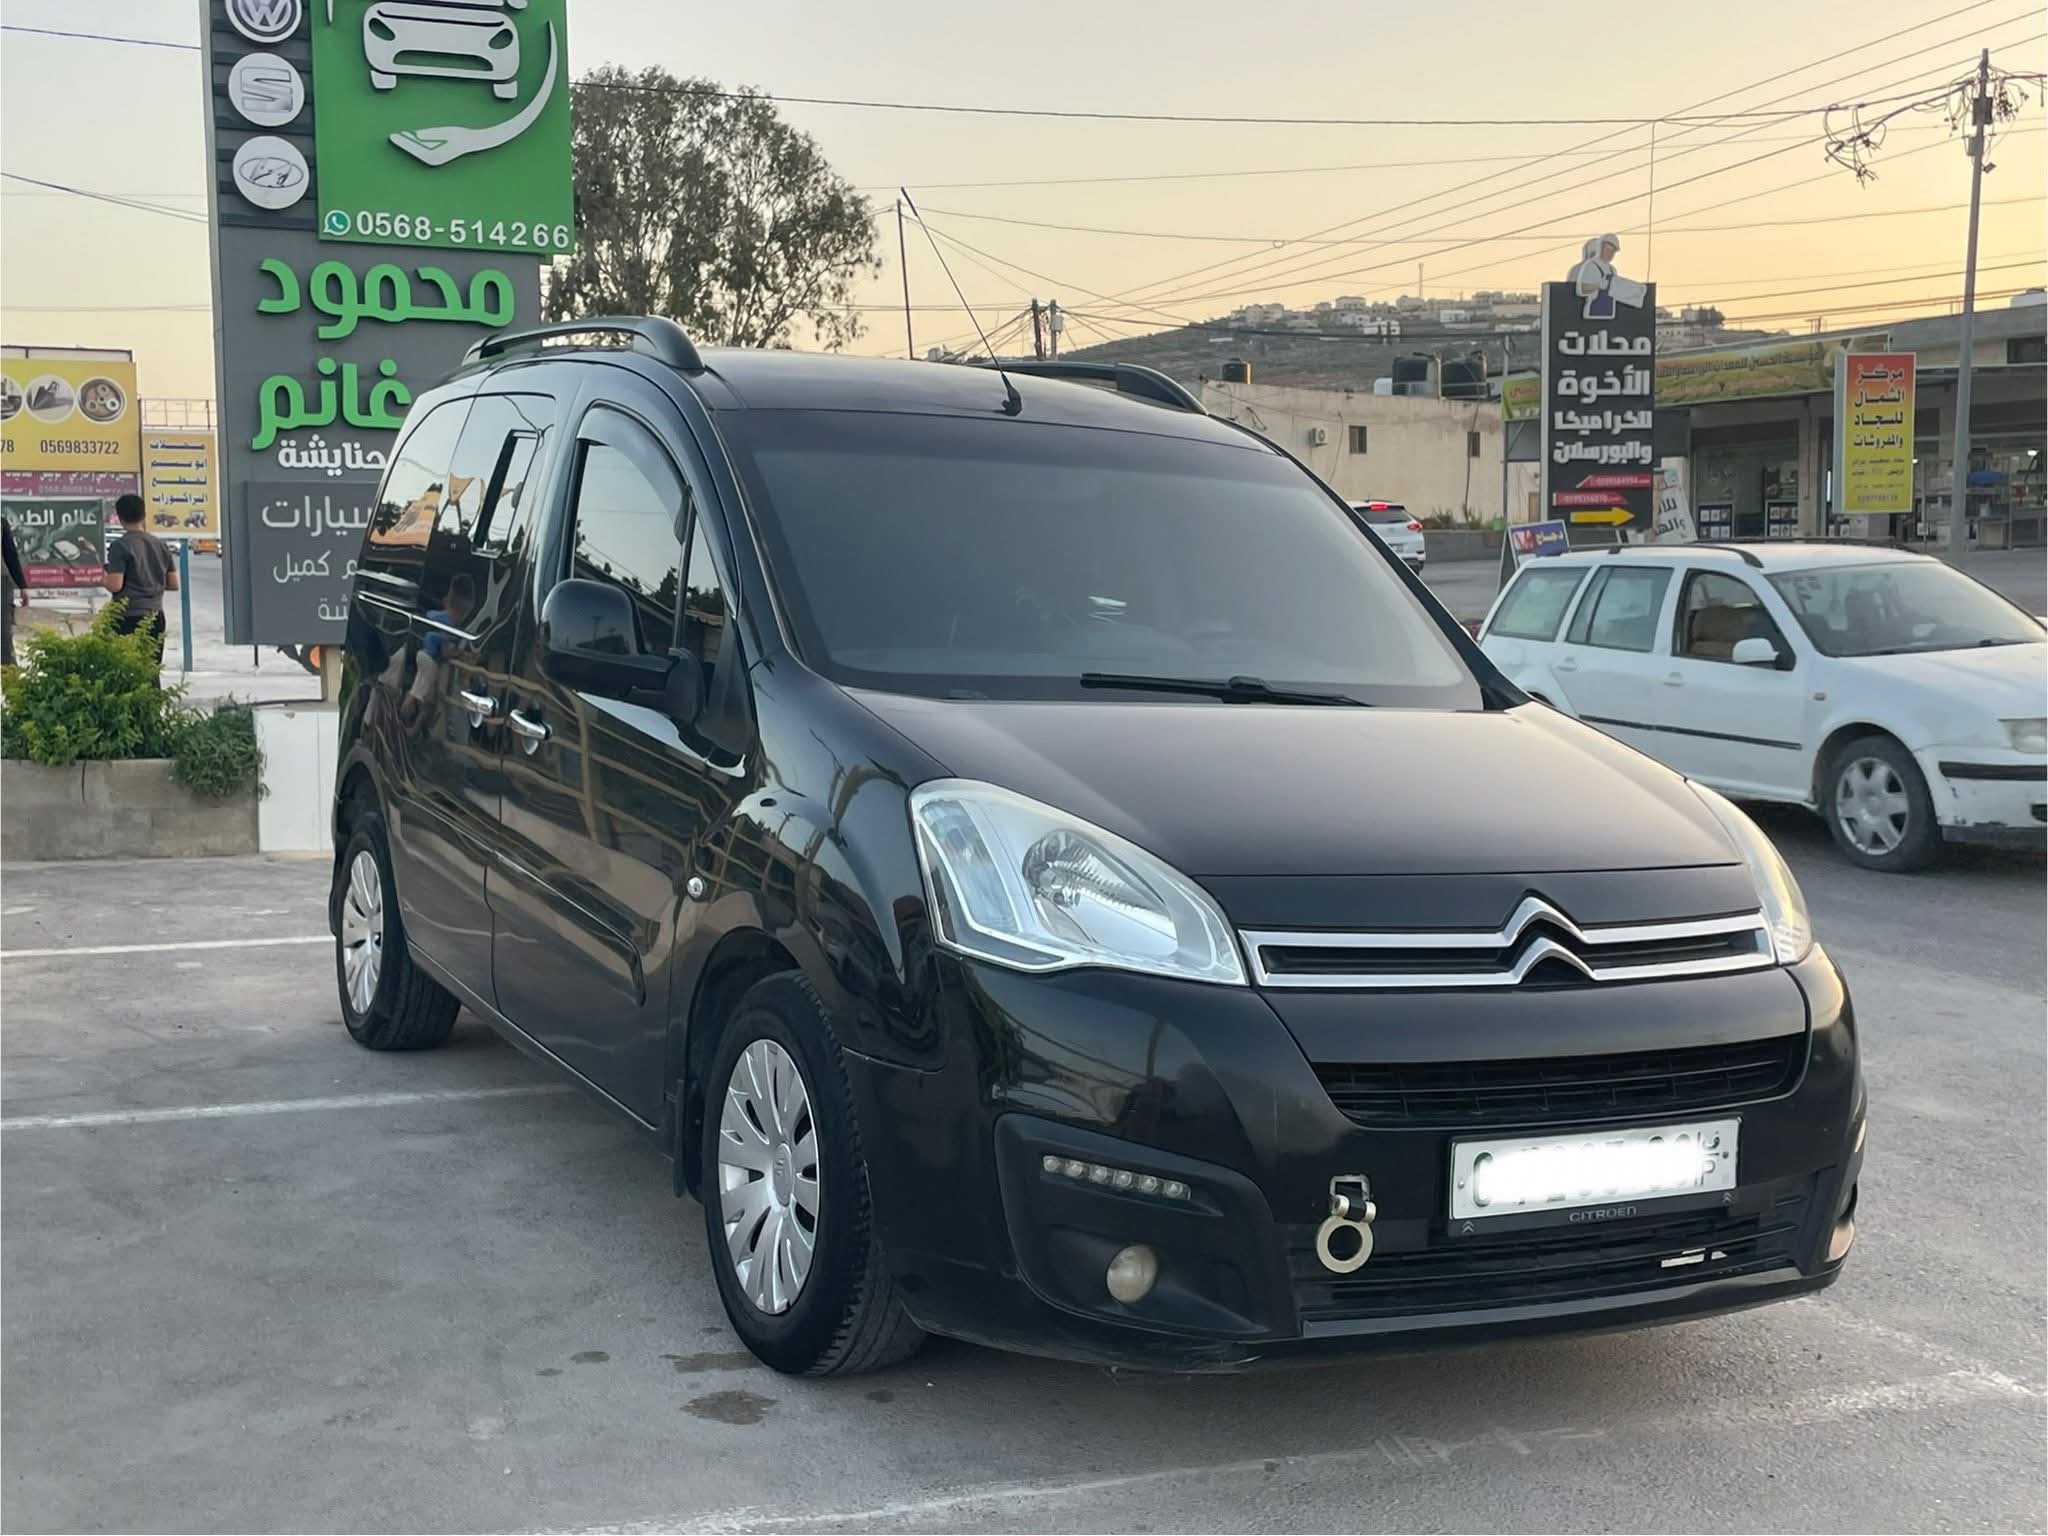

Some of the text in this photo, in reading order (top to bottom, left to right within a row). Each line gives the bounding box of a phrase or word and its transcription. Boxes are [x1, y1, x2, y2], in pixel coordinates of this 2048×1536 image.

[356, 210, 570, 248] 0568-514266
[257, 258, 515, 340] محمود
[1557, 330, 1652, 356] محلات
[1556, 364, 1650, 404] الأخوة
[1857, 364, 1904, 384] مركز
[251, 357, 412, 450] غانم
[1854, 387, 1904, 408] الشمال
[1554, 411, 1653, 435] للكراميكا
[1854, 411, 1904, 430] للسجاد
[41, 440, 119, 455] 0569833722
[1553, 441, 1653, 465] والبورسلان
[1854, 434, 1904, 449] والمفروشات
[62, 509, 97, 528] عالم
[273, 550, 331, 584] كميل
